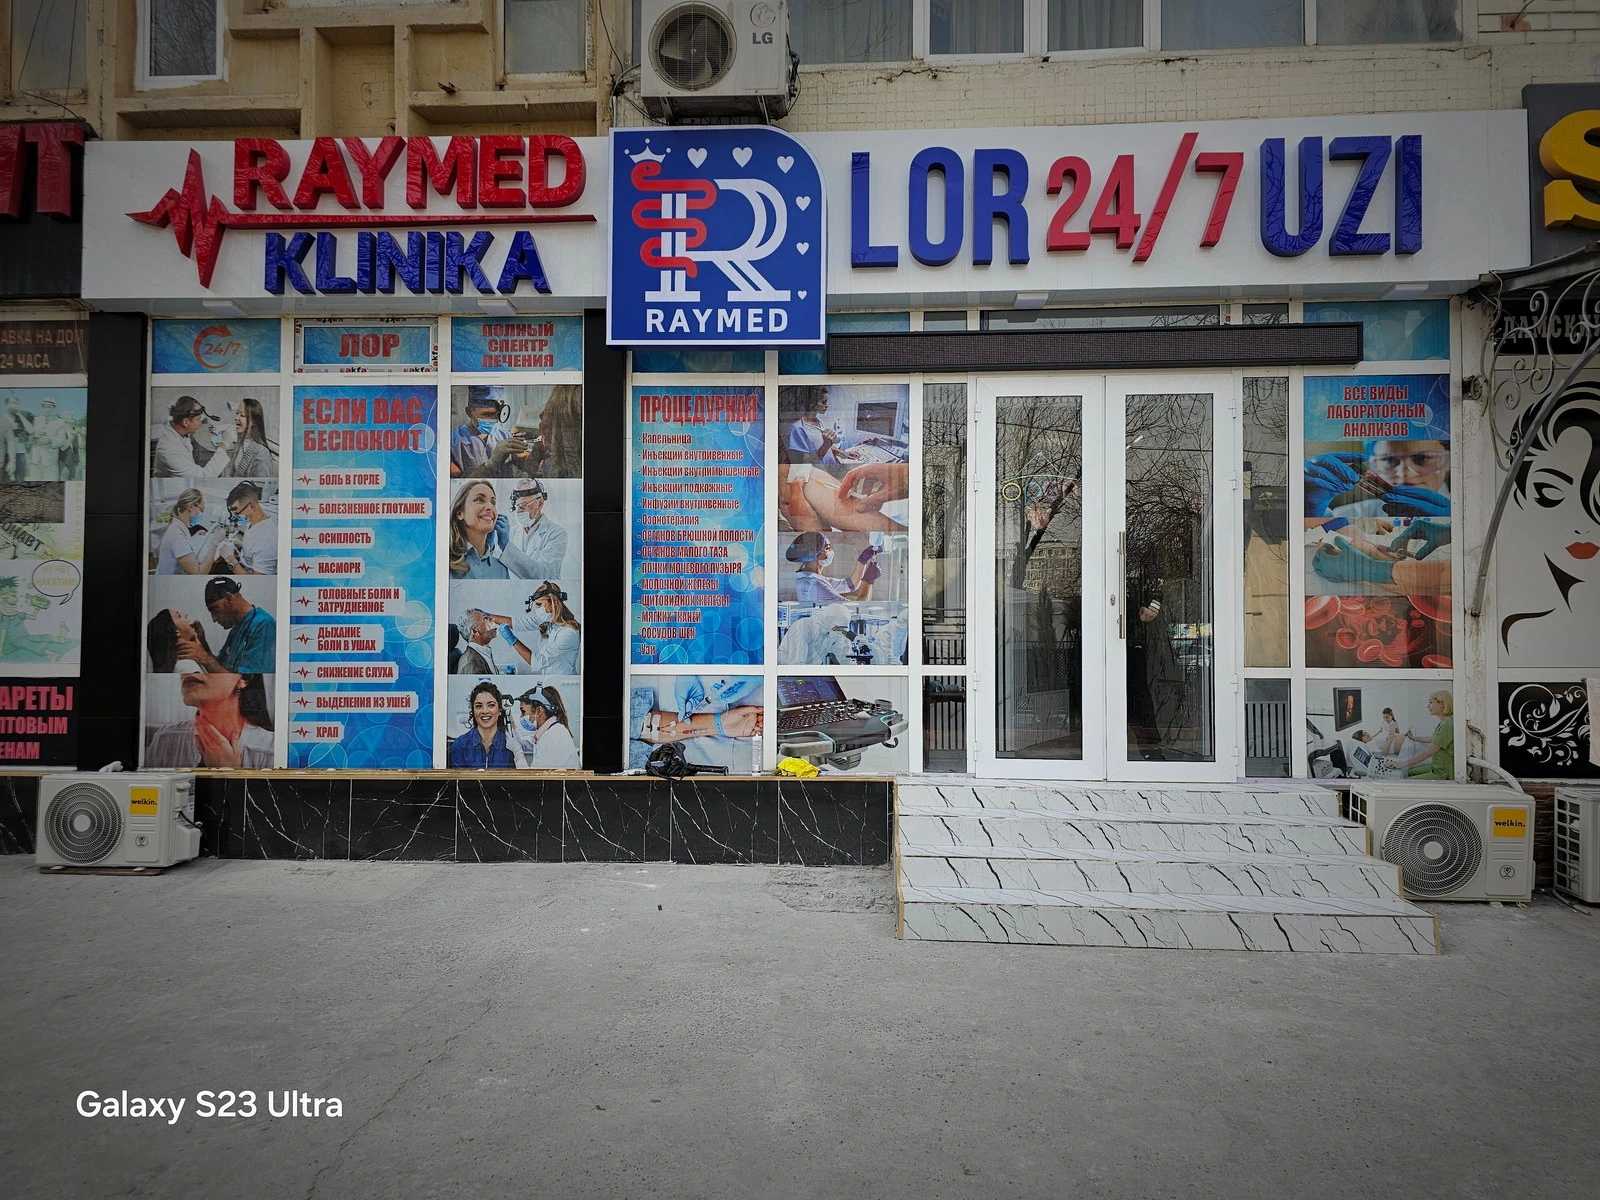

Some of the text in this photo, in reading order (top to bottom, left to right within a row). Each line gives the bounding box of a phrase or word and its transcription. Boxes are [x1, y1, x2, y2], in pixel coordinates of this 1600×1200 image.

[752, 32, 773, 44] LG
[233, 135, 587, 211] RAYMED
[851, 132, 1423, 268] LOR 24/7 UZI
[264, 230, 553, 295] KLINIKA
[646, 308, 788, 333] RAYMED
[482, 321, 554, 337] ПОЛНЫЙ
[36, 329, 53, 344] НА
[56, 328, 84, 346] ДОМ
[204, 341, 241, 356] 24/7
[338, 333, 400, 358] ЛОР
[488, 339, 549, 353] СПЕКТР
[17, 353, 50, 368] ЧАСА
[481, 354, 554, 368] ЛЕЧЕНИЯ
[1344, 385, 1408, 402] ВСЕ ВИДЫ
[303, 397, 423, 425] ЕСЛИ ВАС
[640, 395, 758, 427] ПРОЦЕДУРНАЯ
[1327, 403, 1426, 419] ЛАБОРАТОРНЫХ
[1343, 422, 1409, 437] АНАЛИЗОВ
[303, 429, 423, 452] БЕСПОКОИТ
[642, 432, 692, 445] Капельница
[642, 449, 743, 461] Инъекции внутривенные
[642, 465, 759, 477] Инъекции внутримышечные
[319, 474, 380, 486] БОЛЬ В ГОРЛЕ
[642, 482, 733, 494] Инъекции подкожные
[319, 503, 425, 515] БОЛЕЗНЕННОЕ ГЛОТАНИЕ
[642, 498, 739, 510] Инфузии внутривенные
[642, 514, 699, 526] Озонотерапия
[318, 532, 372, 544] ОСИПЛОСТЬ
[642, 528, 754, 541] ОРГАНОВ БРЮШНОЙ ПОЛОСТИ
[642, 546, 728, 558] ОРГАНОВ МАЛОГО ТАЗА
[318, 562, 361, 574] НАСМОРК
[642, 562, 742, 574] ПОЧКИ МОЧЕВОГО ПУЗЫРЯ
[642, 576, 719, 590] МОЛОЧНОЙ ЖЕЛЕЗЫ
[317, 588, 400, 600] ГОЛОВНЫЕ БОЛИ И
[642, 593, 730, 607] ЩИТОВИДНОЙ ЖЕЛЕЗЫ
[317, 601, 384, 614] ЗАТРУДНЕННОЕ
[642, 609, 701, 623] МЯГКИХ ТКАНЕЙ
[317, 626, 361, 639] ДЫХАНИЕ
[642, 627, 677, 640] СОСУДОВ
[317, 640, 376, 651] БОЛИ В УШАХ
[316, 666, 394, 678] СНИЖЕНИЕ СЛУХА
[0, 686, 74, 711] АРЕТЫ
[316, 694, 411, 709] ВЫДЕЛЕНИЯ ИЗ УШЕЙ
[316, 727, 339, 738] ХРАП
[1494, 818, 1526, 828] welkin.
